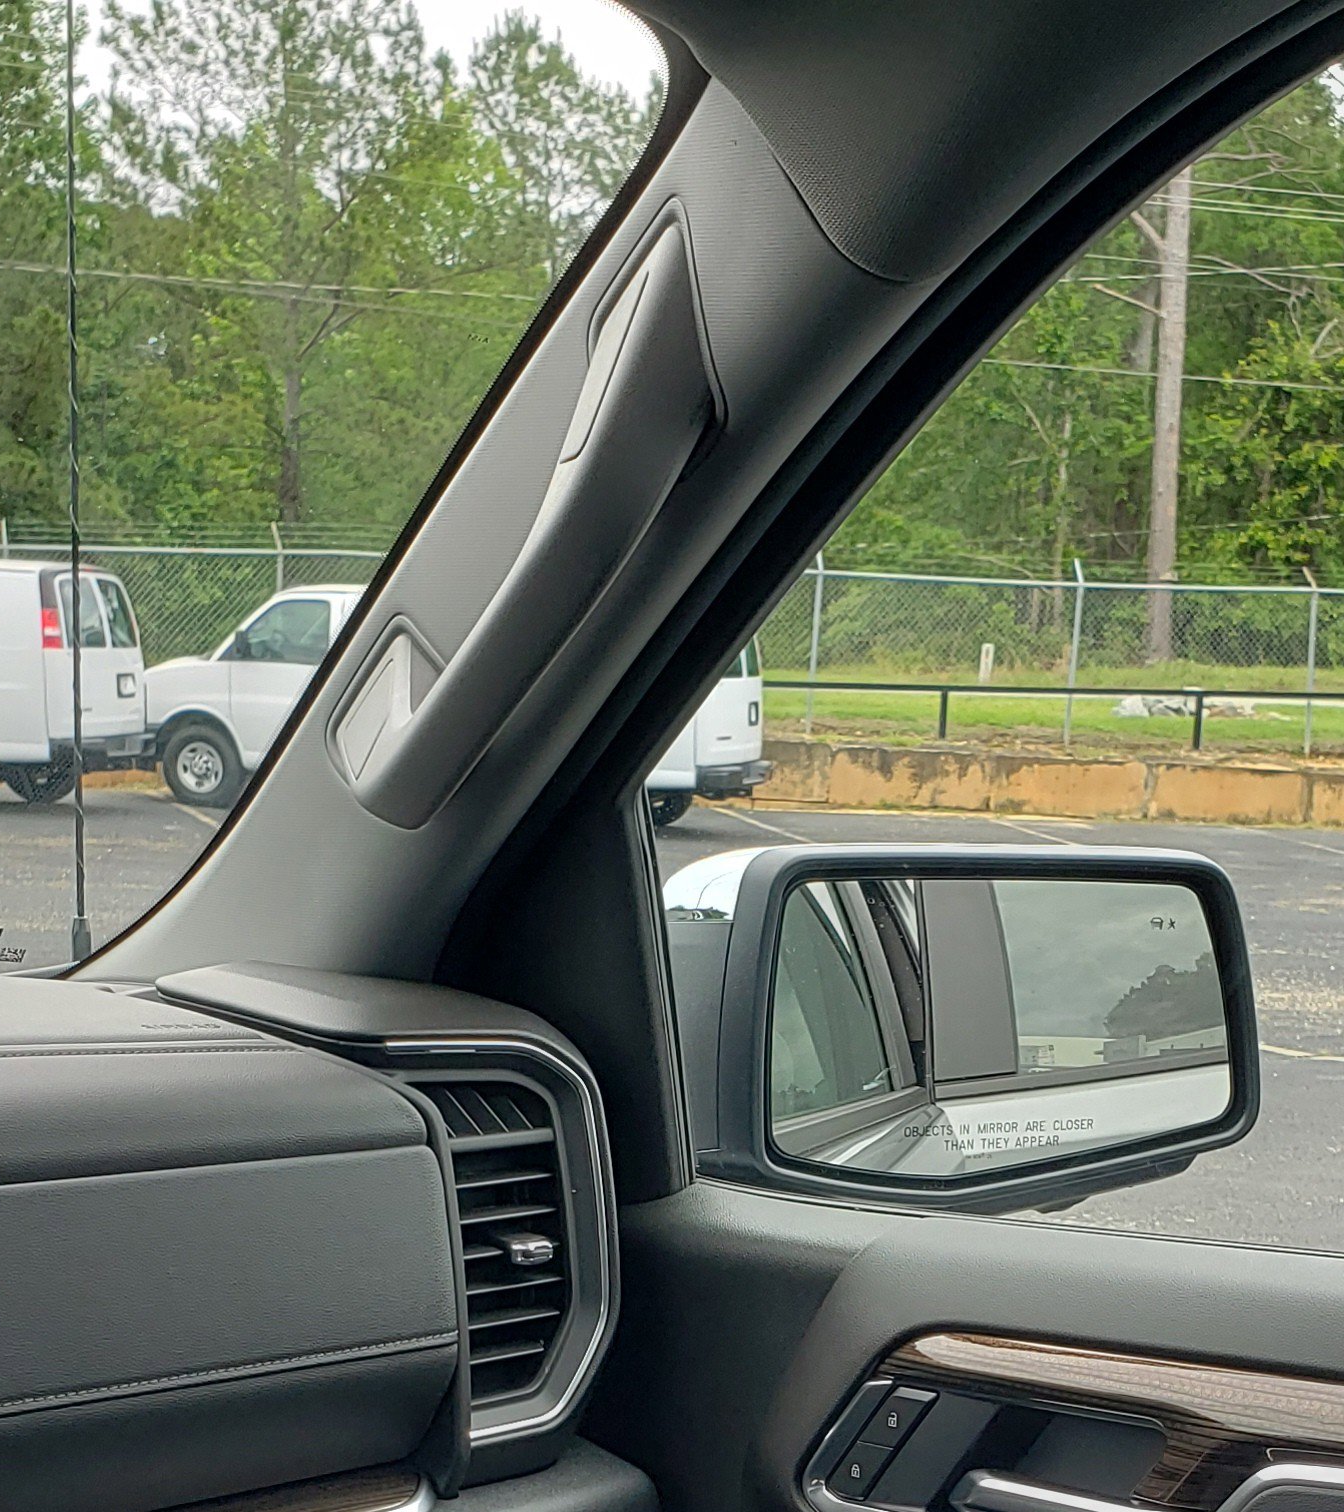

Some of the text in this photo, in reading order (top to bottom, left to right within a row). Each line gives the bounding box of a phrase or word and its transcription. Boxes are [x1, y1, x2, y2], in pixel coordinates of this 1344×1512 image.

[904, 1118, 1094, 1138] OBJECTS IN MIRROR ARE CLOSER
[944, 1135, 1060, 1152] THAN THEY APPEAR
